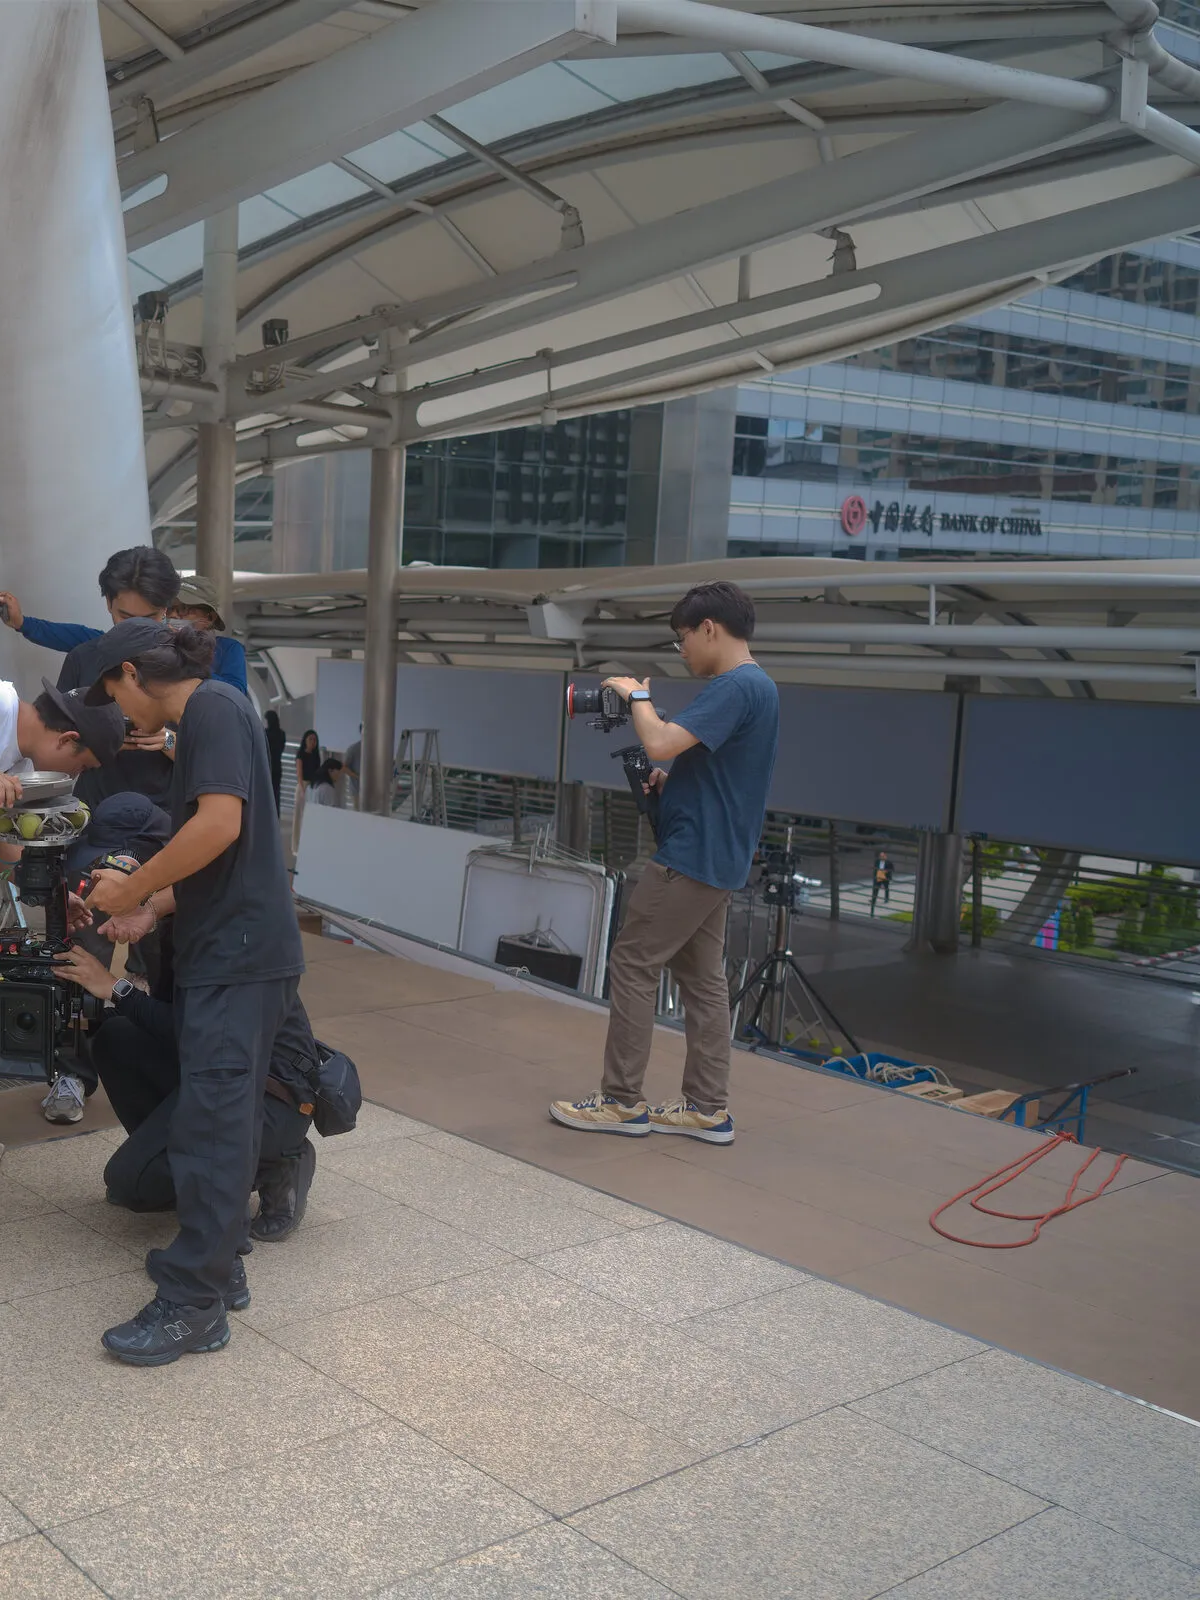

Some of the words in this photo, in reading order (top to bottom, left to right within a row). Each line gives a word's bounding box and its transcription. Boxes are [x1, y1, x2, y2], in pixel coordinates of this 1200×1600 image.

[940, 512, 979, 533] BANK
[980, 515, 1001, 535] OF
[1000, 517, 1042, 536] CHINA
[163, 1319, 192, 1341] N
